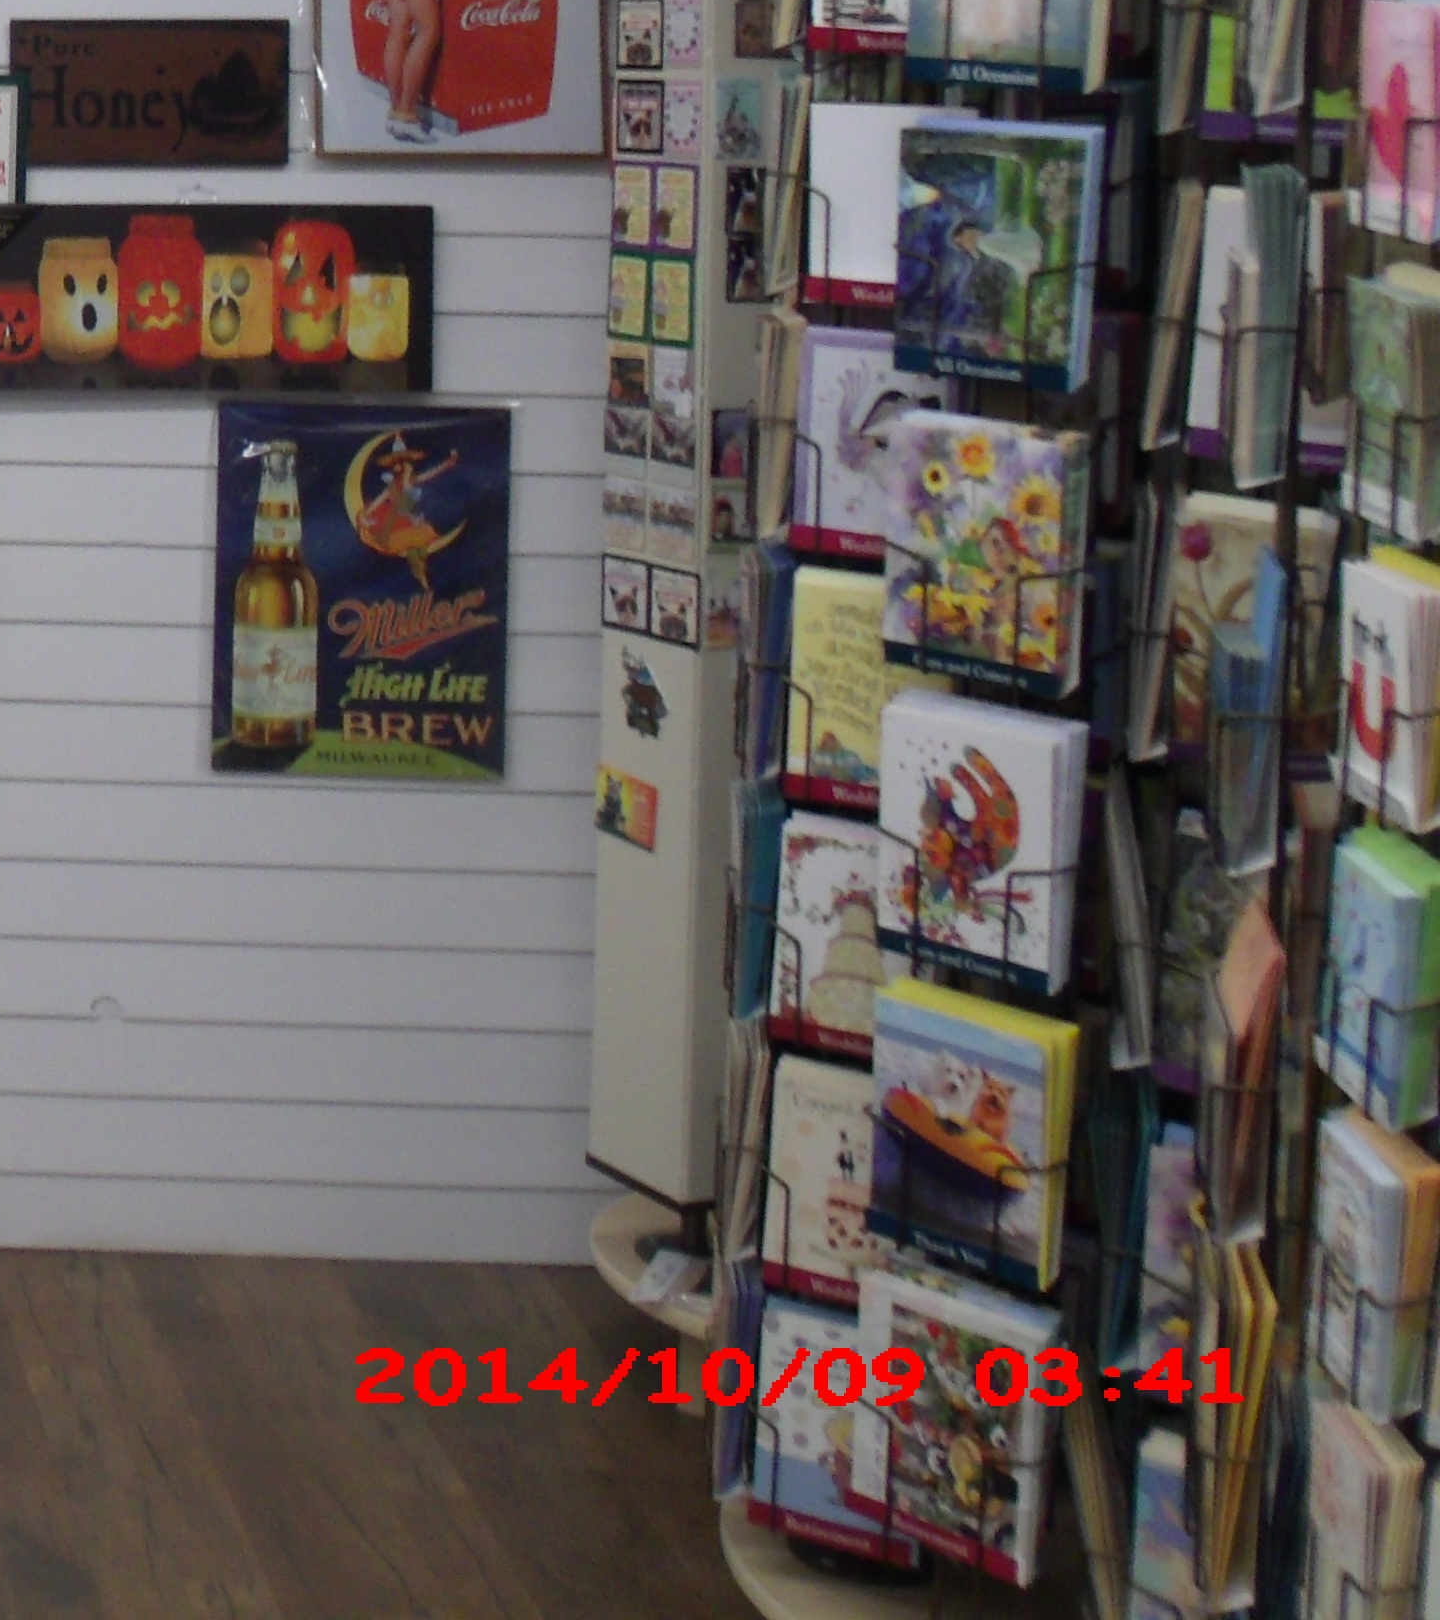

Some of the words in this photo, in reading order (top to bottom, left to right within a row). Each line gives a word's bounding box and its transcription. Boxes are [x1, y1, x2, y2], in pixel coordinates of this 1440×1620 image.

[32, 35, 96, 57] Pure
[29, 65, 189, 152] Honey
[328, 588, 485, 659] Miller
[343, 711, 493, 746] BREW
